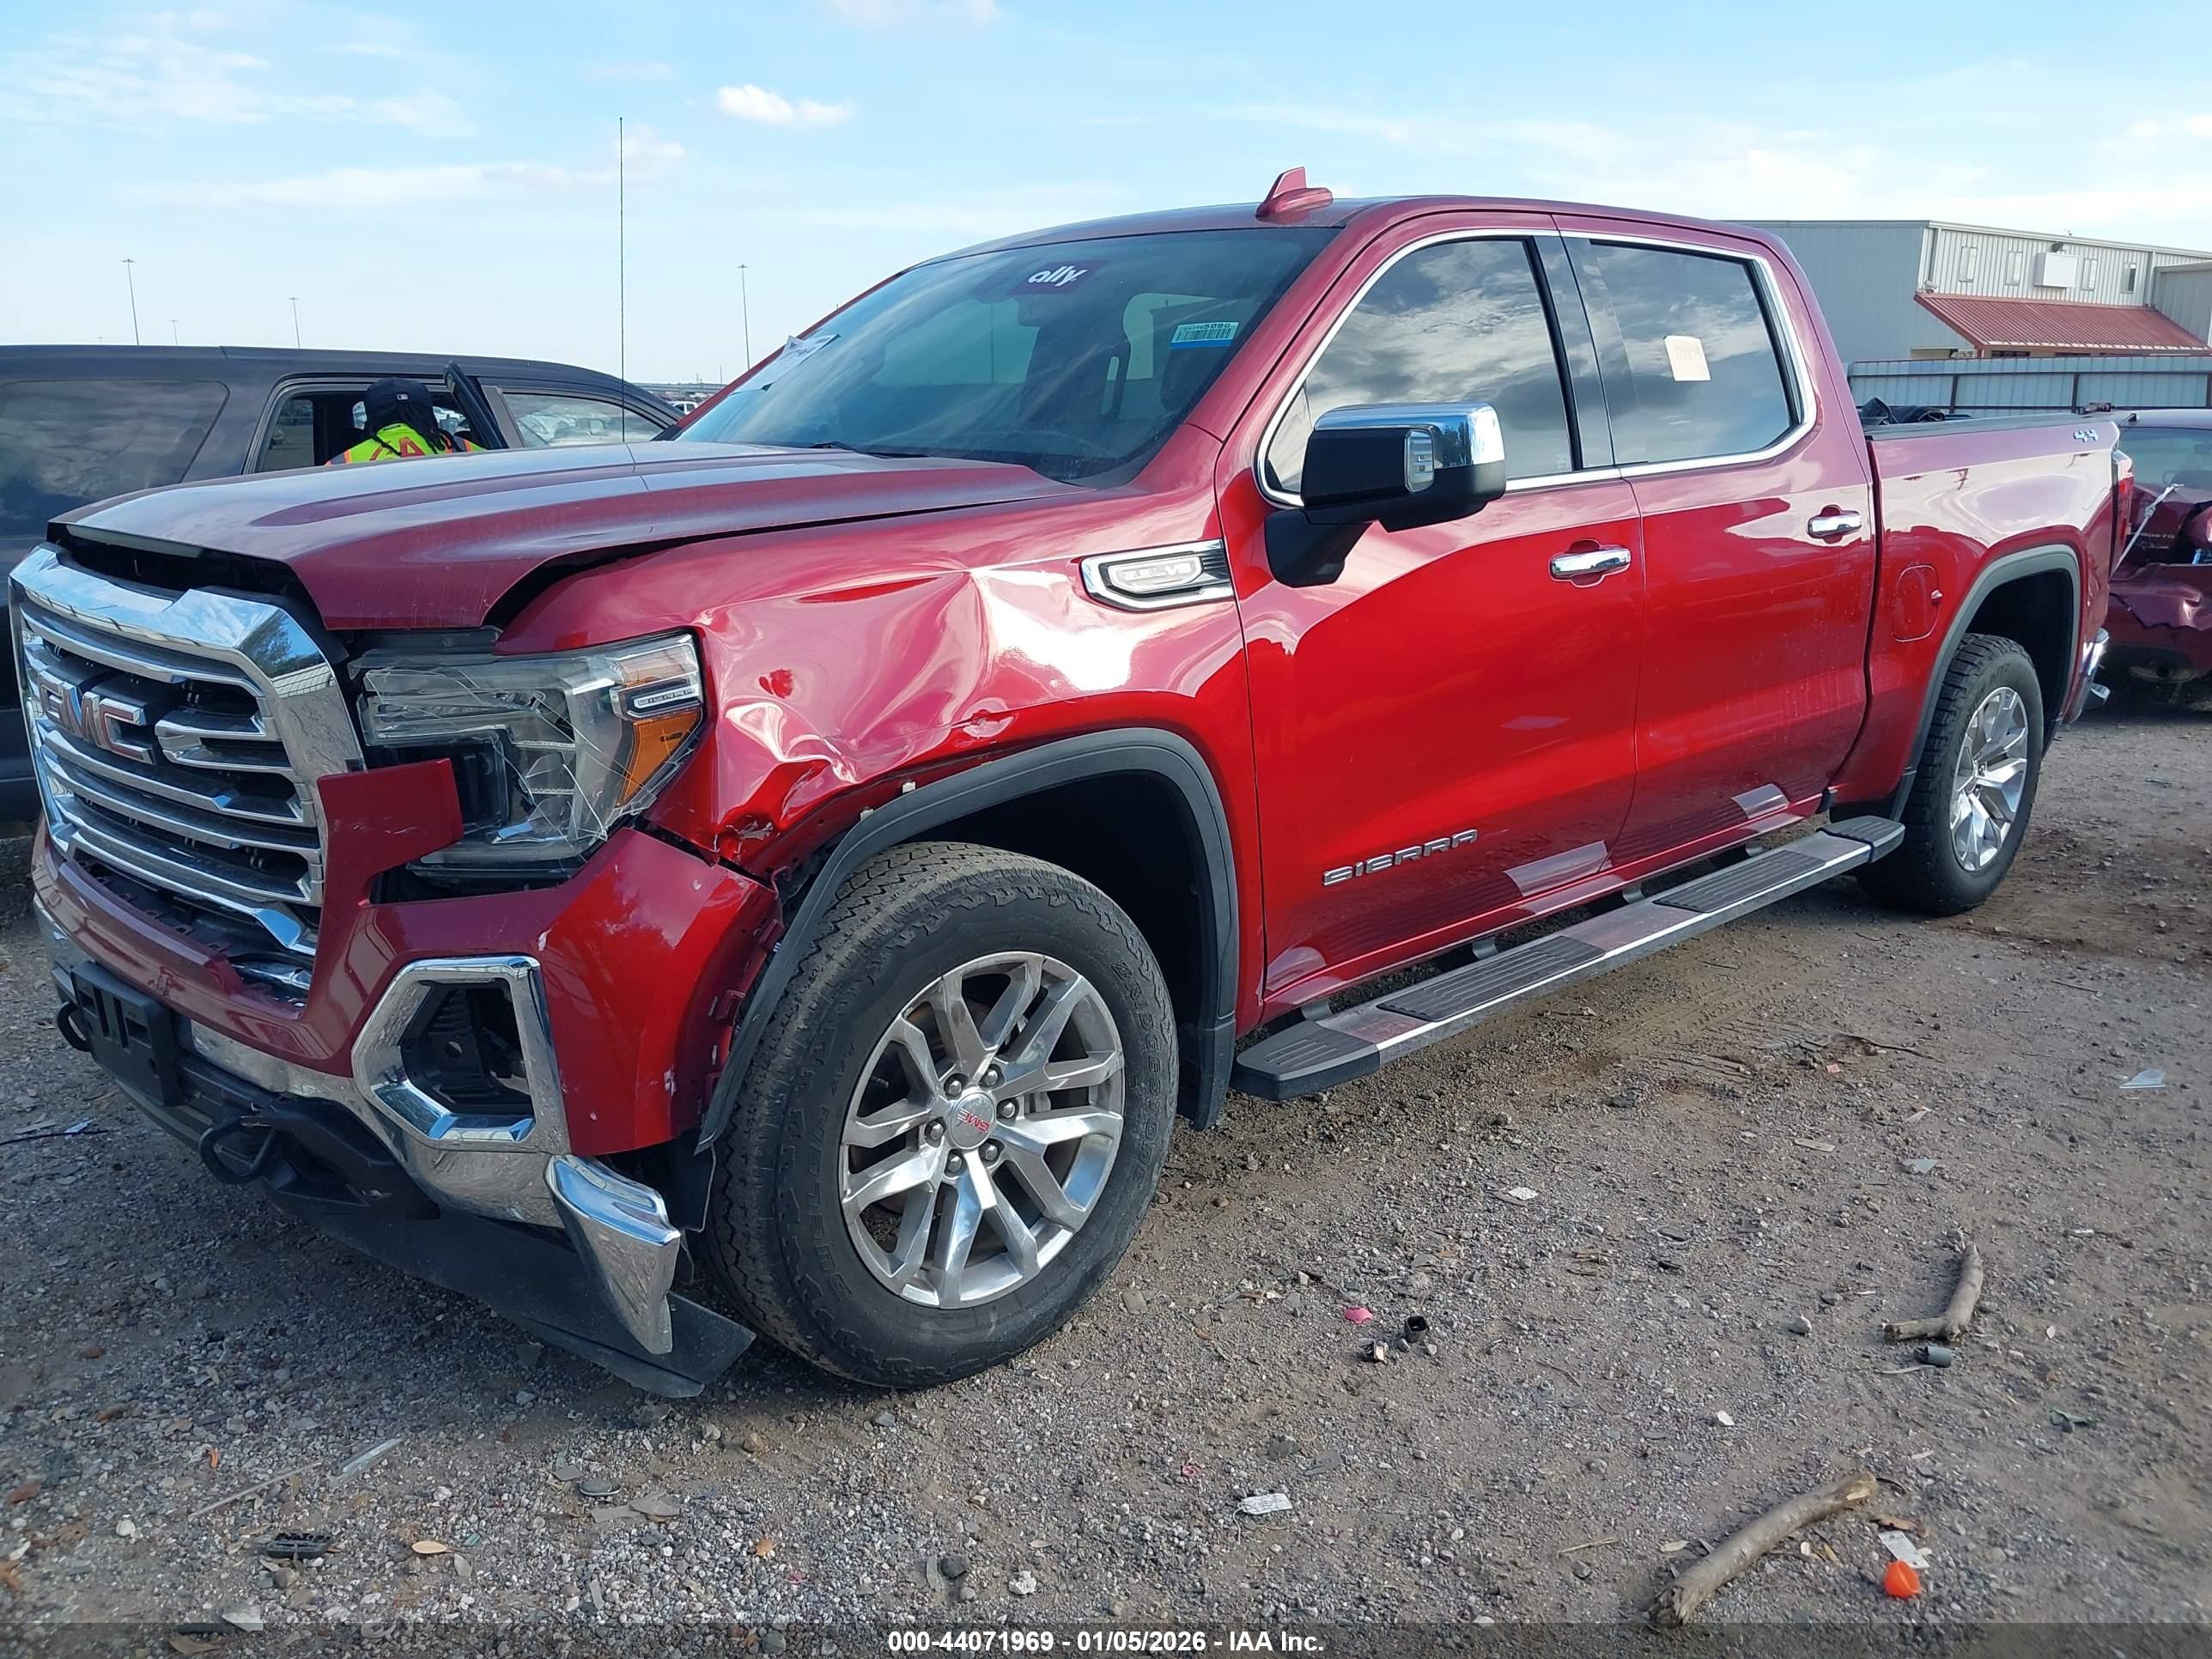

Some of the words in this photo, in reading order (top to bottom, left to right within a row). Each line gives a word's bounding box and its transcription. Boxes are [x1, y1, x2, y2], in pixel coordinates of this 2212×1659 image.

[1028, 265, 1088, 287] ally
[638, 689, 695, 706] SIERRA
[39, 669, 155, 765] GMC
[1322, 829, 1478, 886] SIERRA
[957, 1108, 990, 1133] GMC
